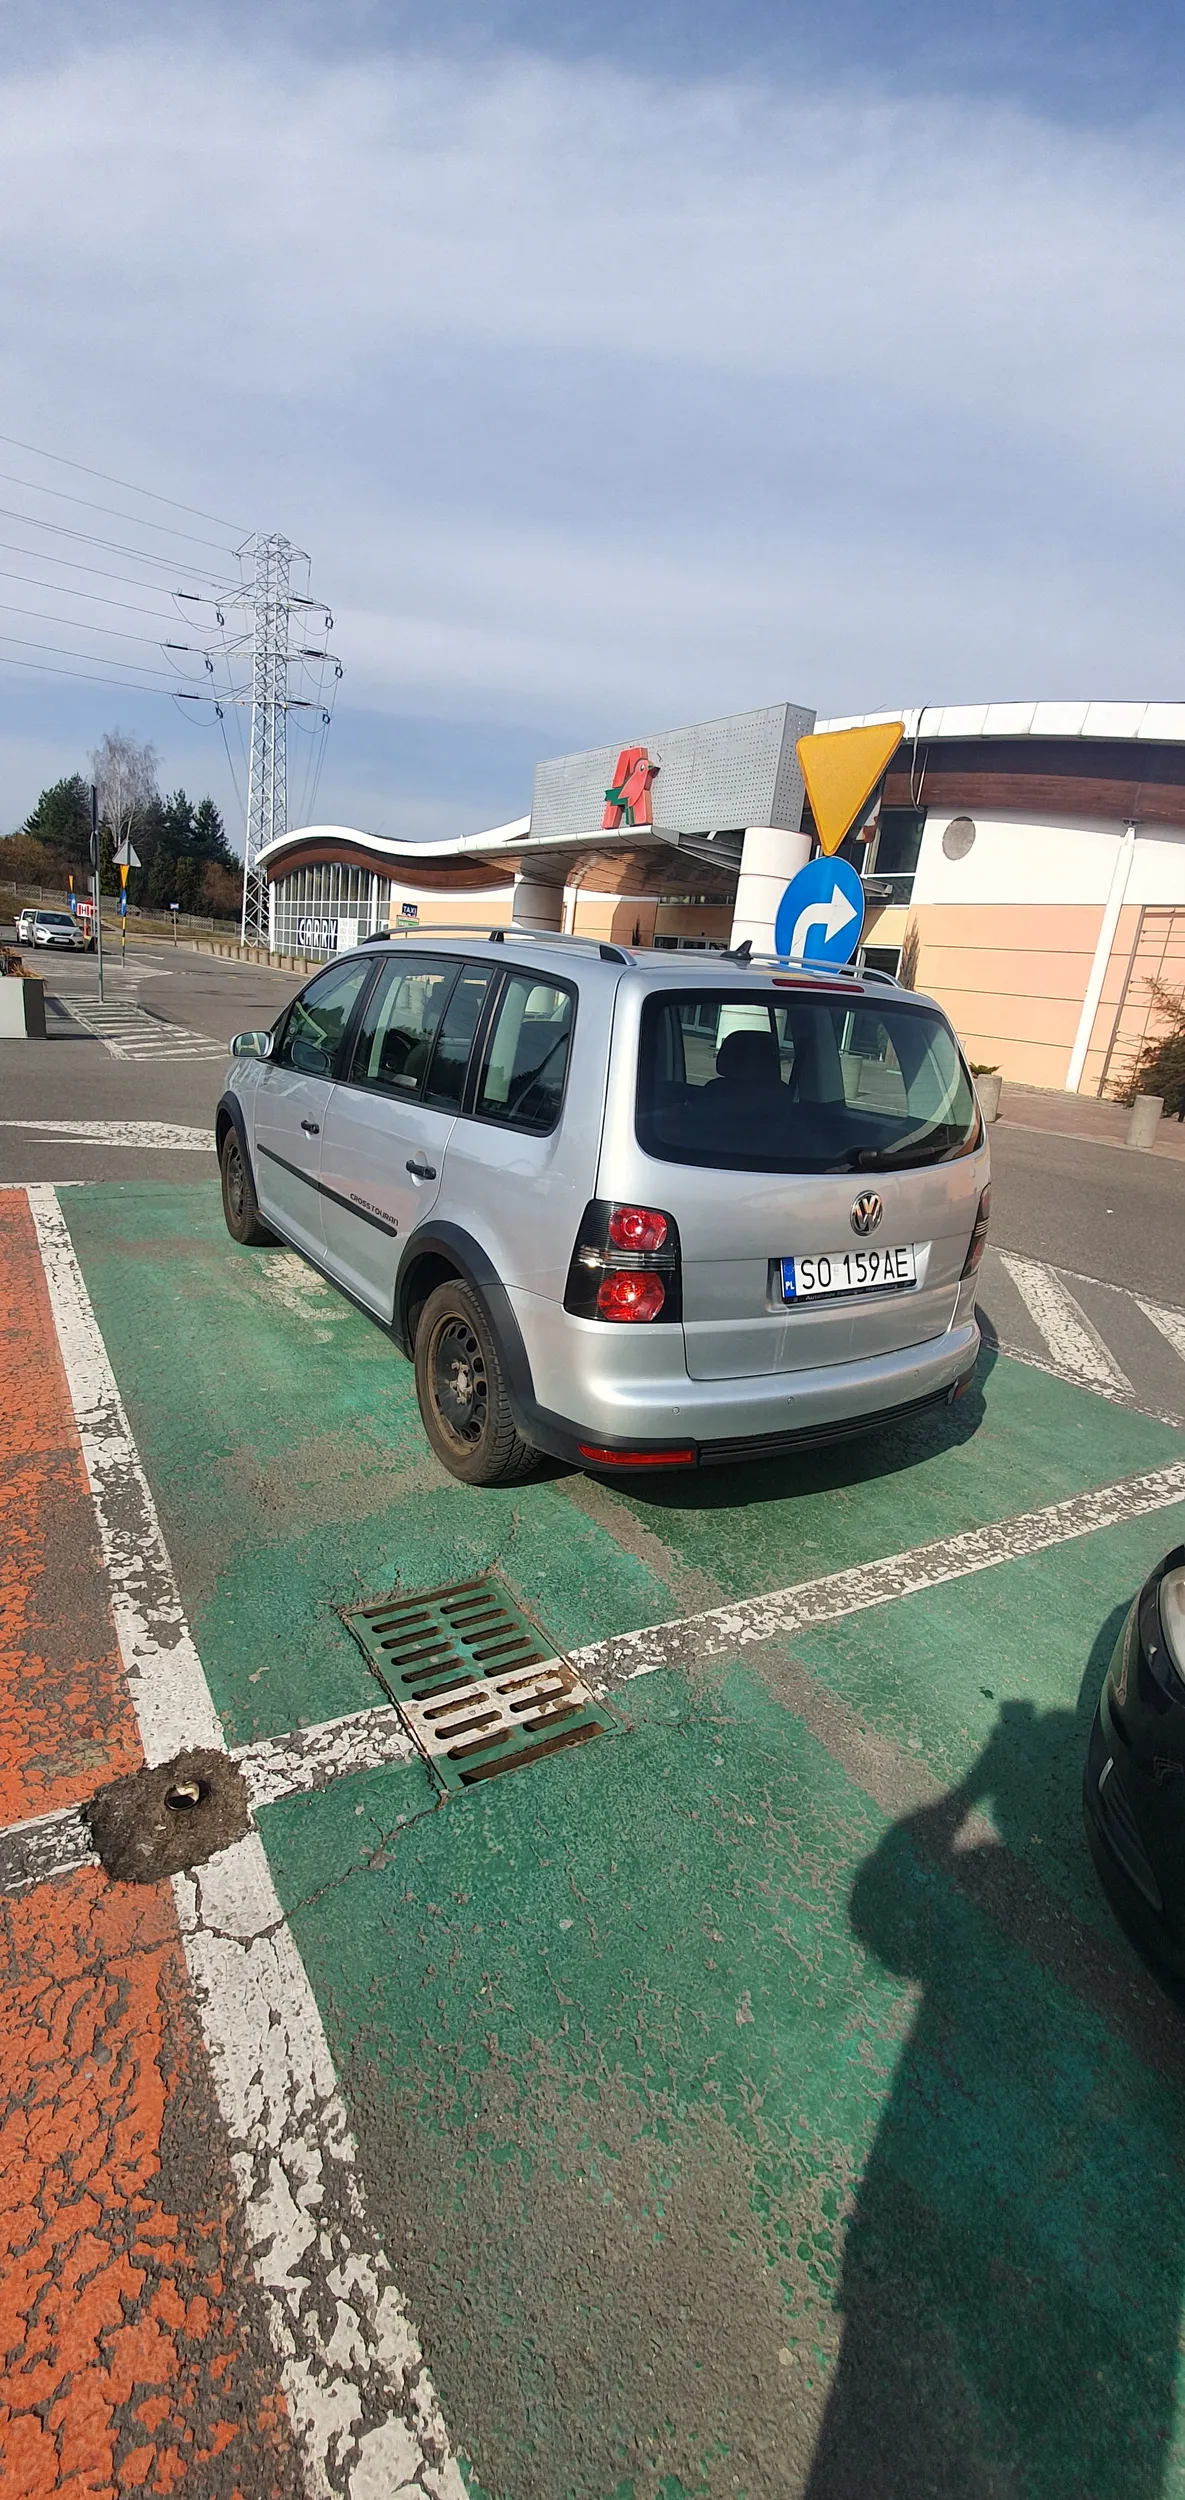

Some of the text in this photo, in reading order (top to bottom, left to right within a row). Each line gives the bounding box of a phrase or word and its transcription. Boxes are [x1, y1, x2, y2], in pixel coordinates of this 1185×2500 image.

[403, 905, 417, 914] TAXI
[299, 918, 338, 949] CARRY
[801, 1248, 909, 1289] SO 159AE
[785, 1281, 795, 1290] PL
